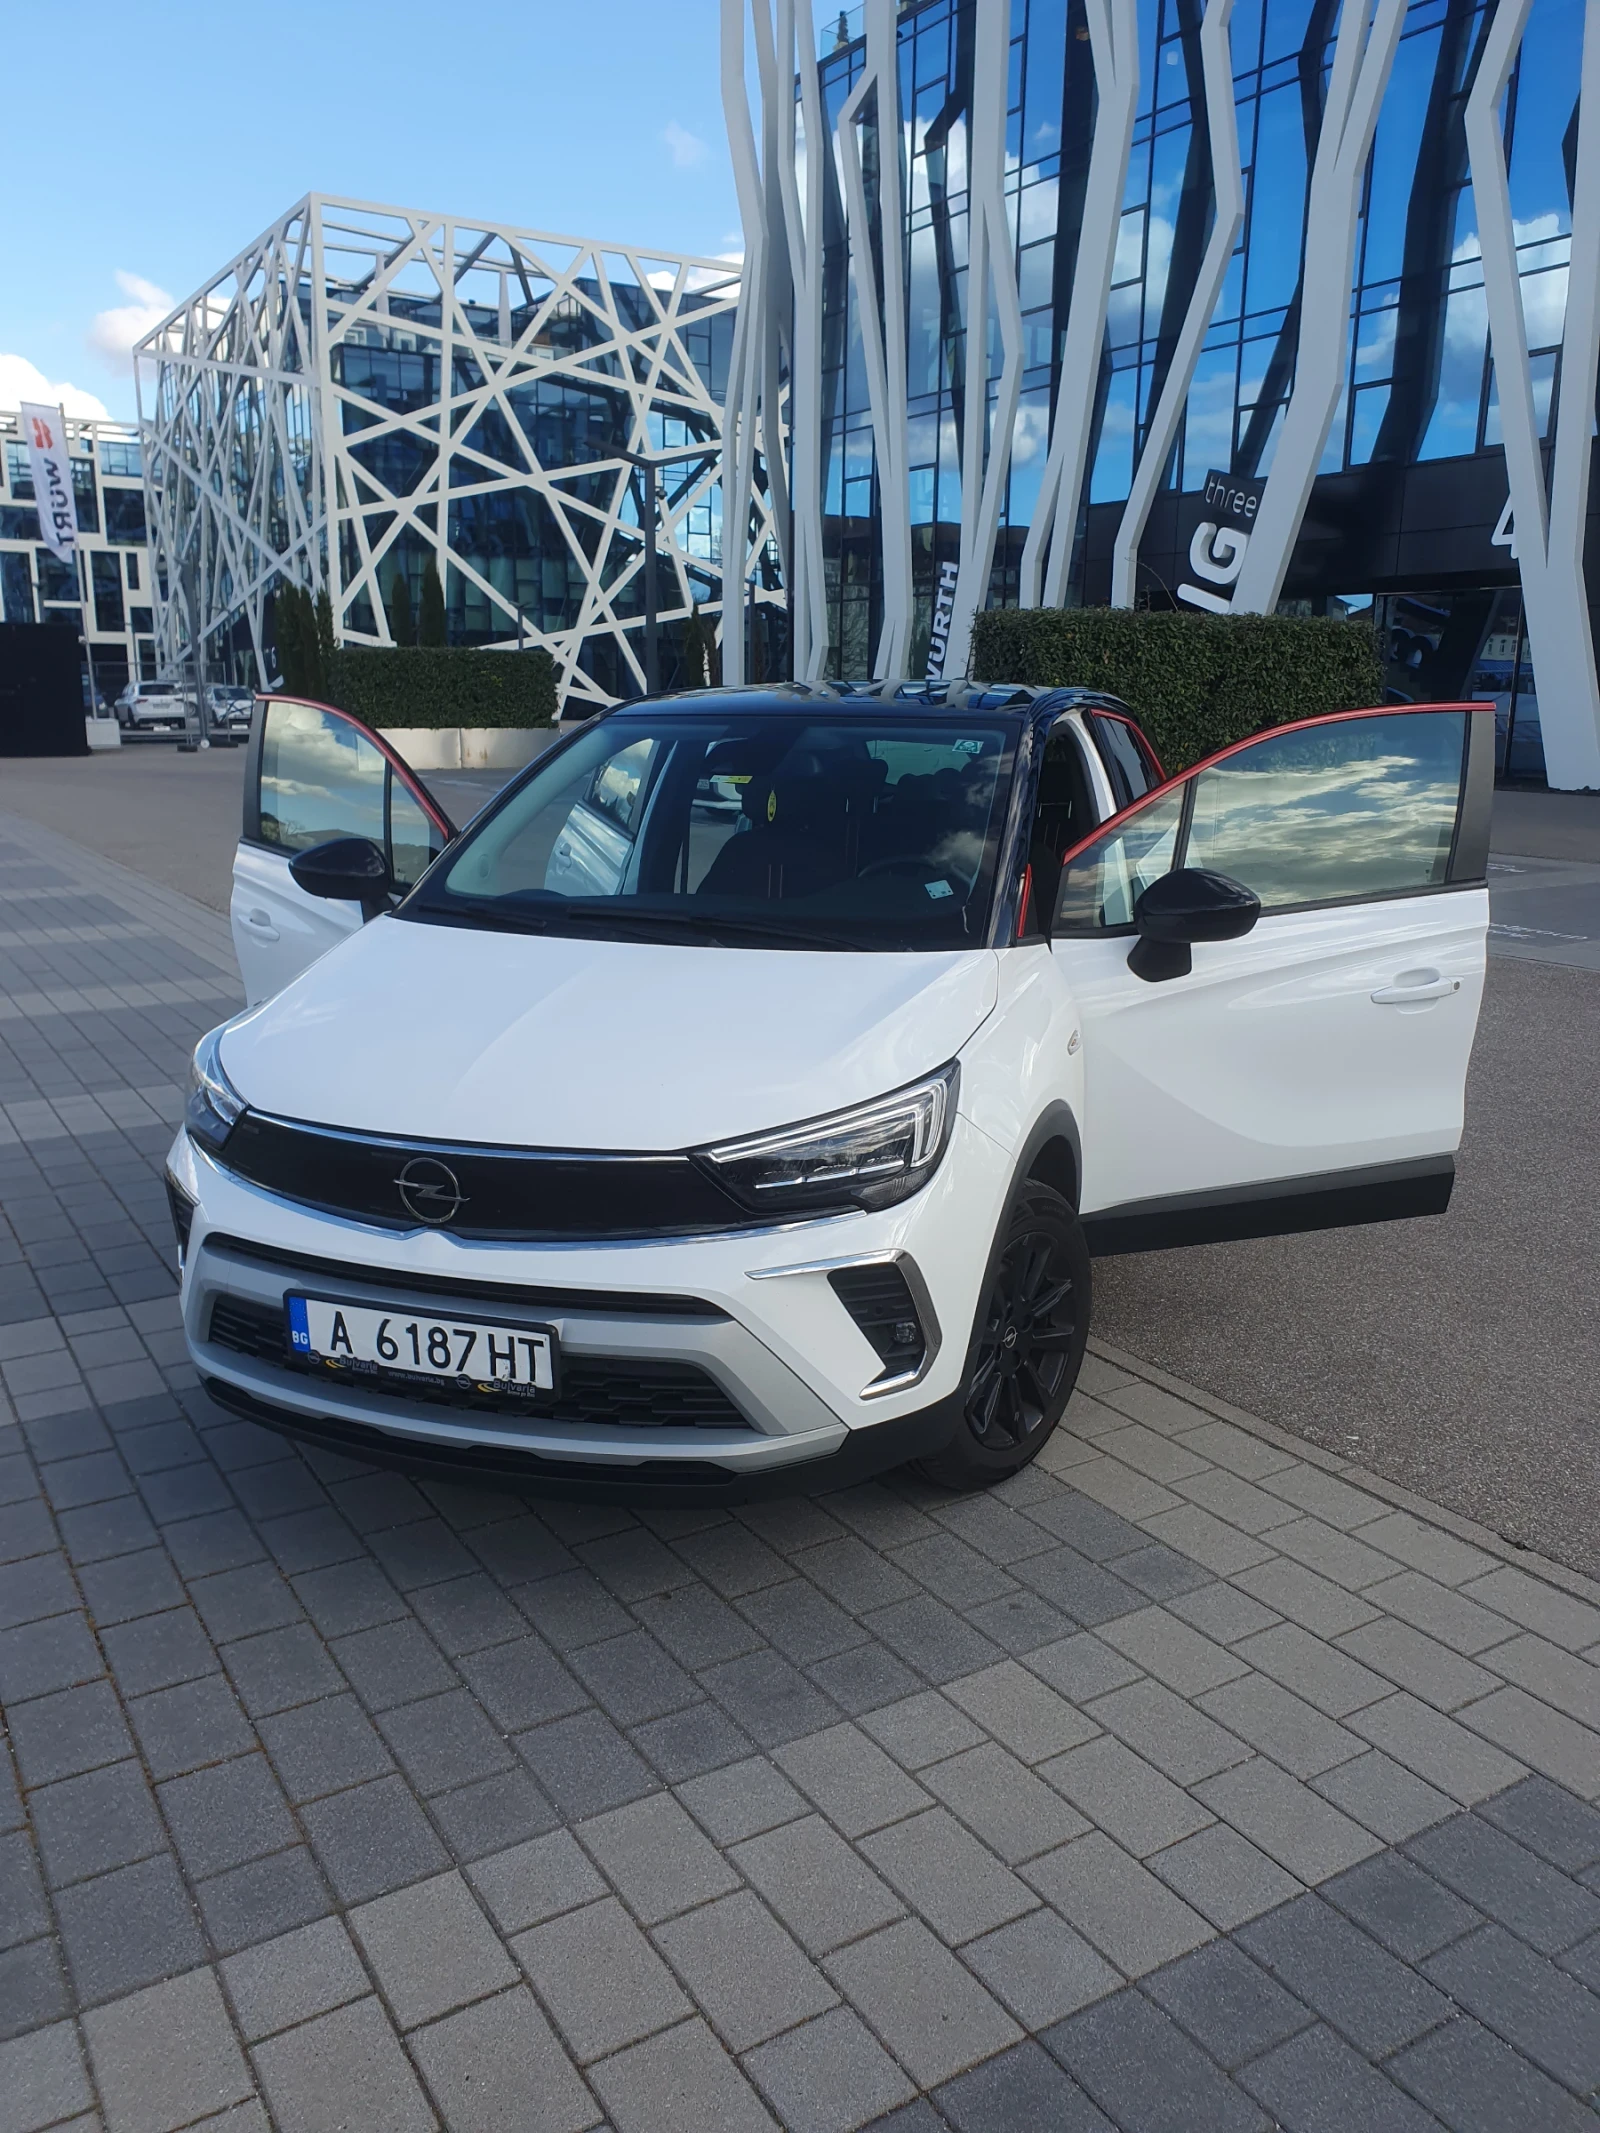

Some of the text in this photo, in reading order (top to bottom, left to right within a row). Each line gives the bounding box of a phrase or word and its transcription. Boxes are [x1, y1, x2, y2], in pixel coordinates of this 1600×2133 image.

[1205, 475, 1257, 518] three
[291, 1330, 309, 1345] BG
[330, 1310, 354, 1354] A
[493, 1379, 536, 1394] Bulvaria
